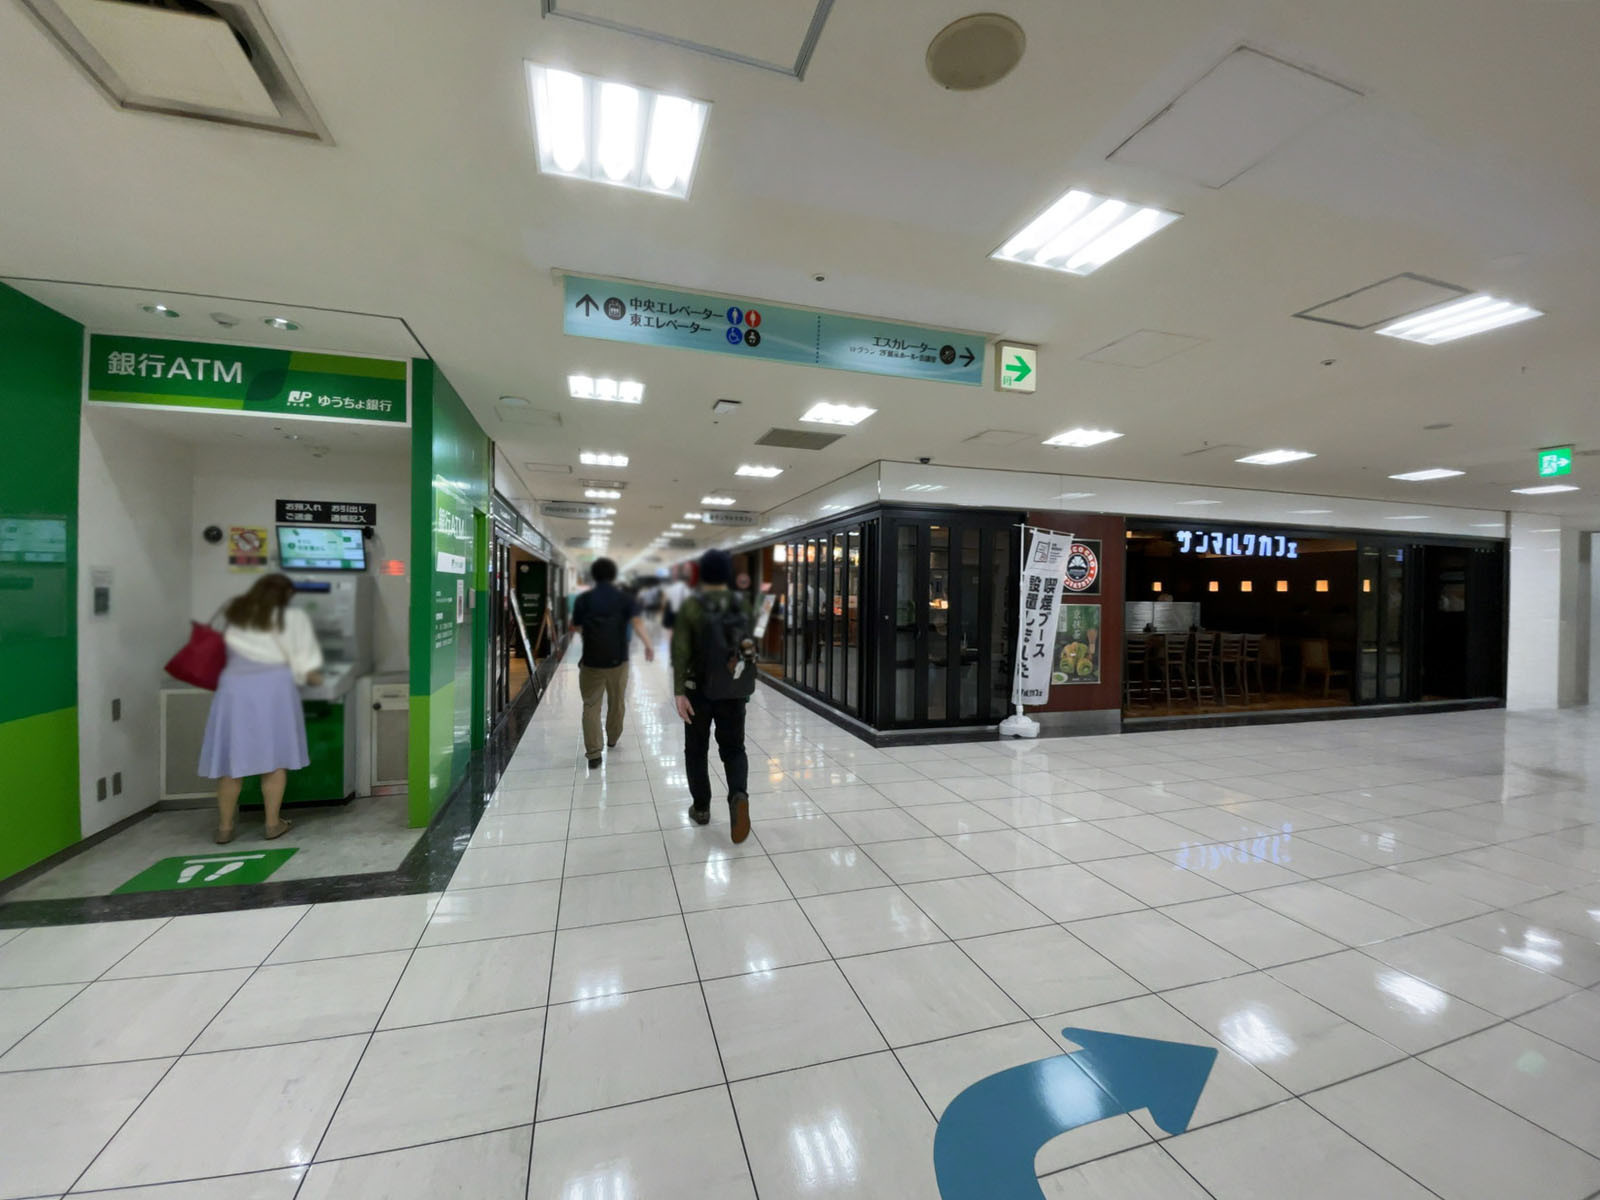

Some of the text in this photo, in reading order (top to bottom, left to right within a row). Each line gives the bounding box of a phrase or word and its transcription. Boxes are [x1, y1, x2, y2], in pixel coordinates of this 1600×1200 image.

[629, 297, 724, 320] 中央エレベーター
[630, 313, 712, 333] 東エレベーター
[872, 336, 937, 353] エスカレーター
[107, 351, 243, 384] 銀行ATM
[318, 395, 392, 412] ゆうちょ銀行
[285, 502, 322, 512] お預入れ
[330, 504, 367, 513] お引出し
[1176, 530, 1298, 558] サンマルクカフェ
